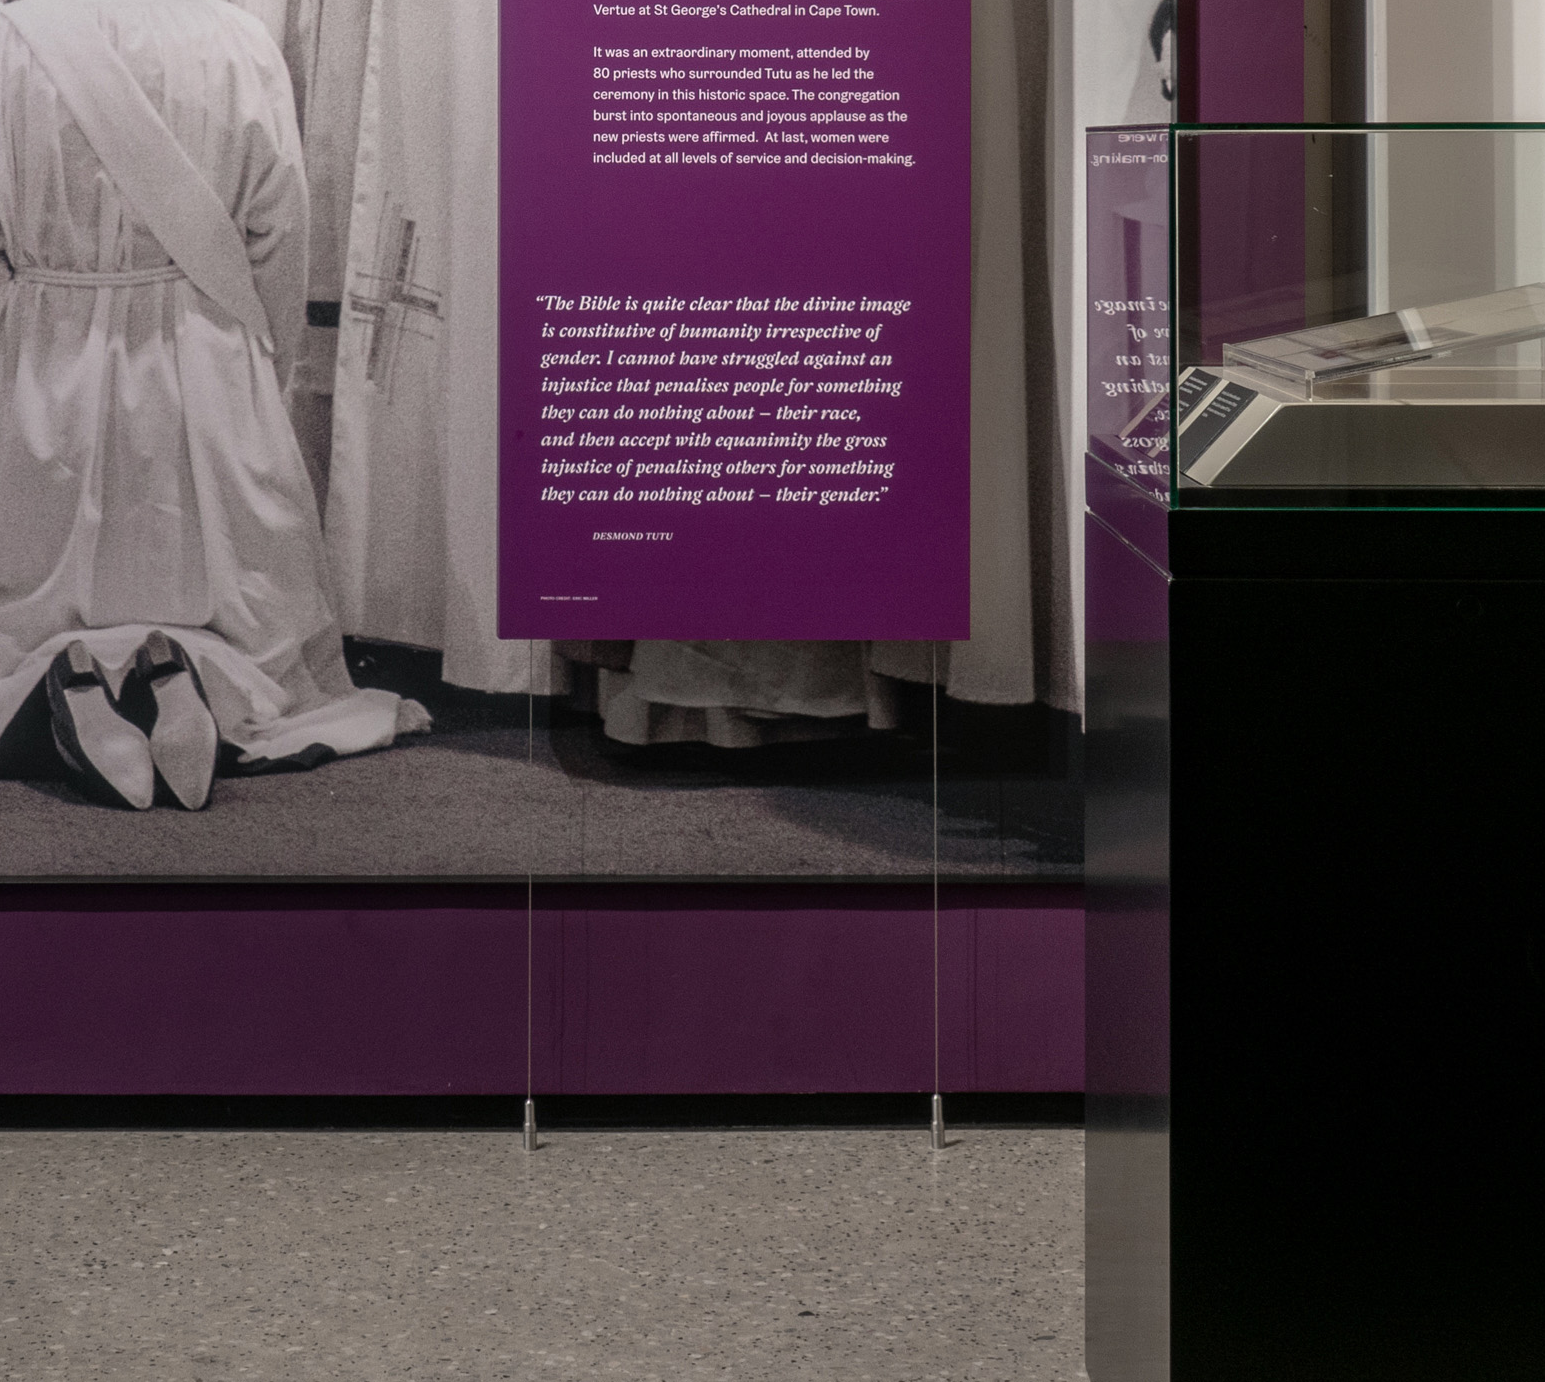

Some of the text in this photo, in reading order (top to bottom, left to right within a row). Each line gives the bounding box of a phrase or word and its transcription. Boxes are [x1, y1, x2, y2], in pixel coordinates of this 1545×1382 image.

[593, 46, 870, 61] It was an extraordinary moment, attended by
[593, 88, 900, 104] ceremony in this historic space. The congregation
[593, 130, 890, 145] new priests were affirmed. At last, women were
[593, 151, 916, 167] included at all levels of service and decision-making.
[536, 295, 912, 316] “The Bible is quite clear that the divine image
[541, 322, 883, 343] is constitutive of humanity irrespective of
[540, 350, 893, 370] gender. I cannot have struggled against an
[541, 404, 576, 423] they
[578, 408, 609, 420] can
[613, 404, 634, 420] do
[638, 404, 704, 424] nothing
[706, 405, 756, 420] about
[776, 405, 818, 420] their
[820, 409, 861, 422] race,
[540, 431, 888, 451] and then accept with equanimity the gross
[541, 458, 896, 479] injustice of penalising others for something
[540, 486, 575, 505] they
[578, 490, 609, 501] can
[613, 486, 634, 501] do
[638, 486, 704, 506] nothing
[705, 486, 755, 502] about
[775, 486, 818, 502] their
[818, 486, 889, 506] gender.”
[592, 532, 674, 541] DESMOND TUTU
